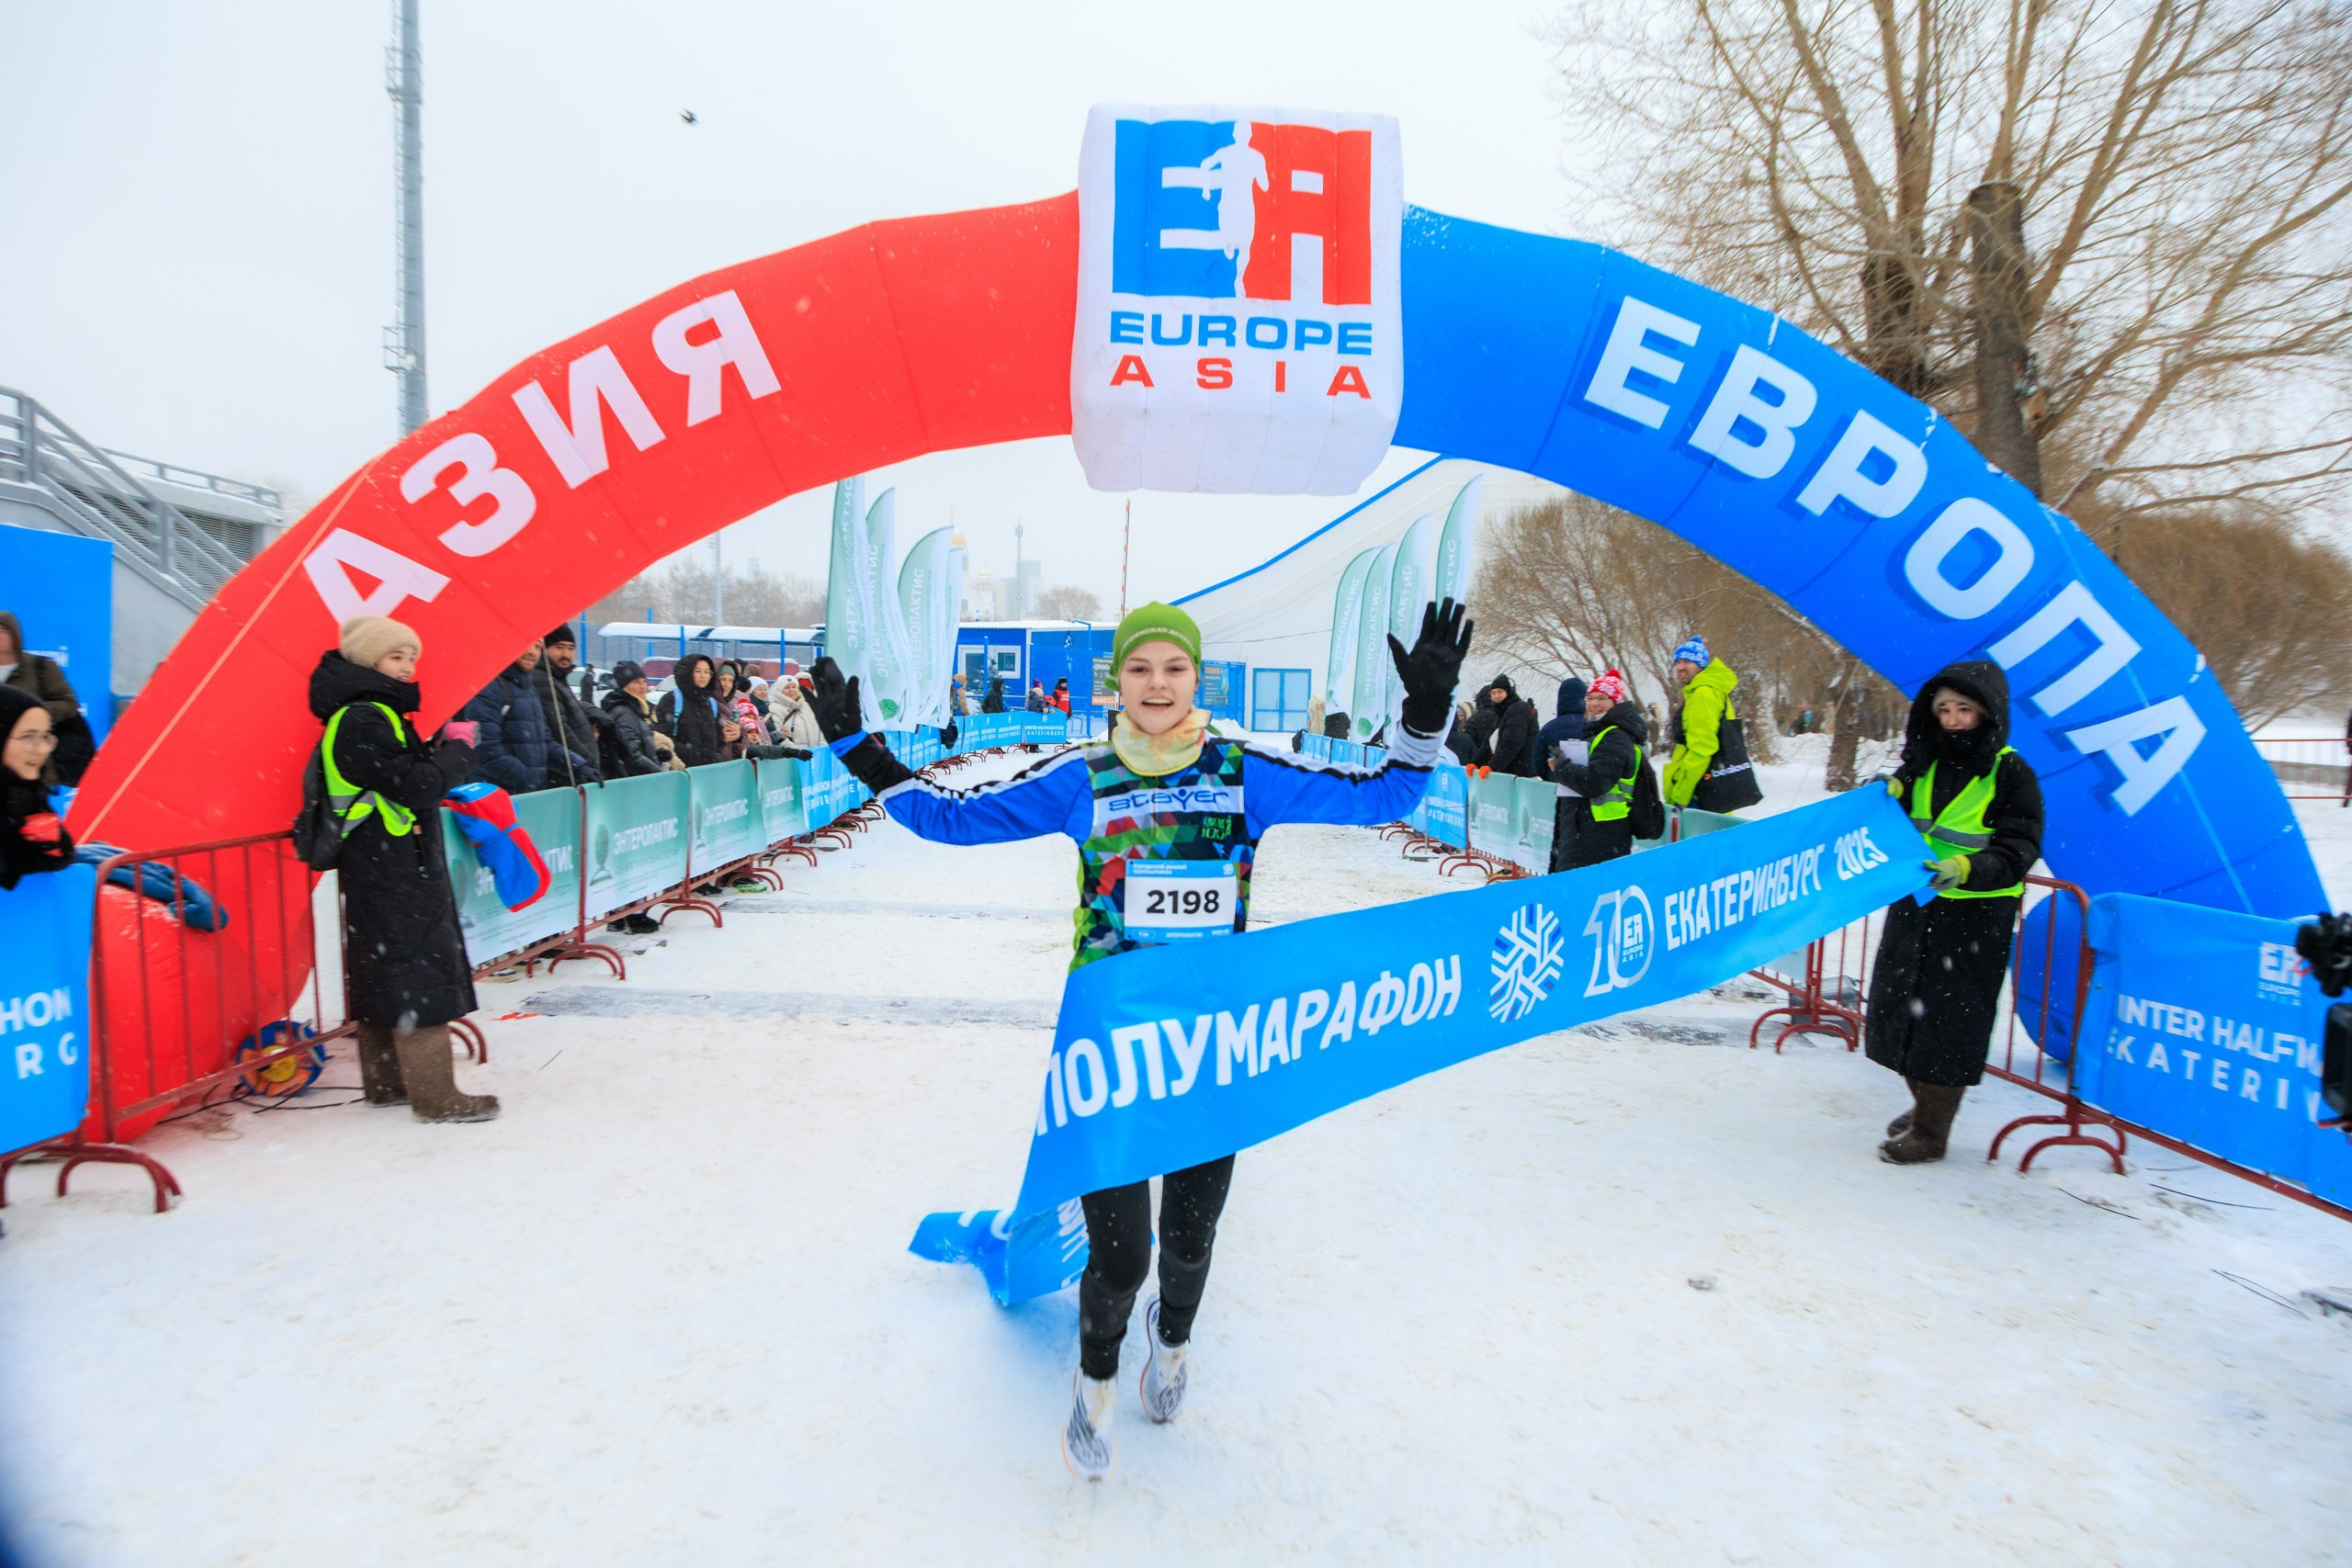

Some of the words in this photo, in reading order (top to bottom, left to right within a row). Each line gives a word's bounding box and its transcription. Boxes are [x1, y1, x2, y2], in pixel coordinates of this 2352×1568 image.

[1110, 311, 1372, 355] EUROPE
[1110, 355, 1372, 399] ASIA
[303, 289, 782, 625] АЗИЯ
[1585, 295, 2207, 816] ЕВРОПА
[1147, 889, 1219, 914] 2198
[1582, 885, 1655, 998] 10
[1665, 843, 1826, 952] ЕКАТЕРИНБУРГ
[1834, 826, 1889, 881] 2025
[1623, 943, 1644, 956] EUROPE
[1036, 953, 1463, 1137] ПОЛУМАРАФОН
